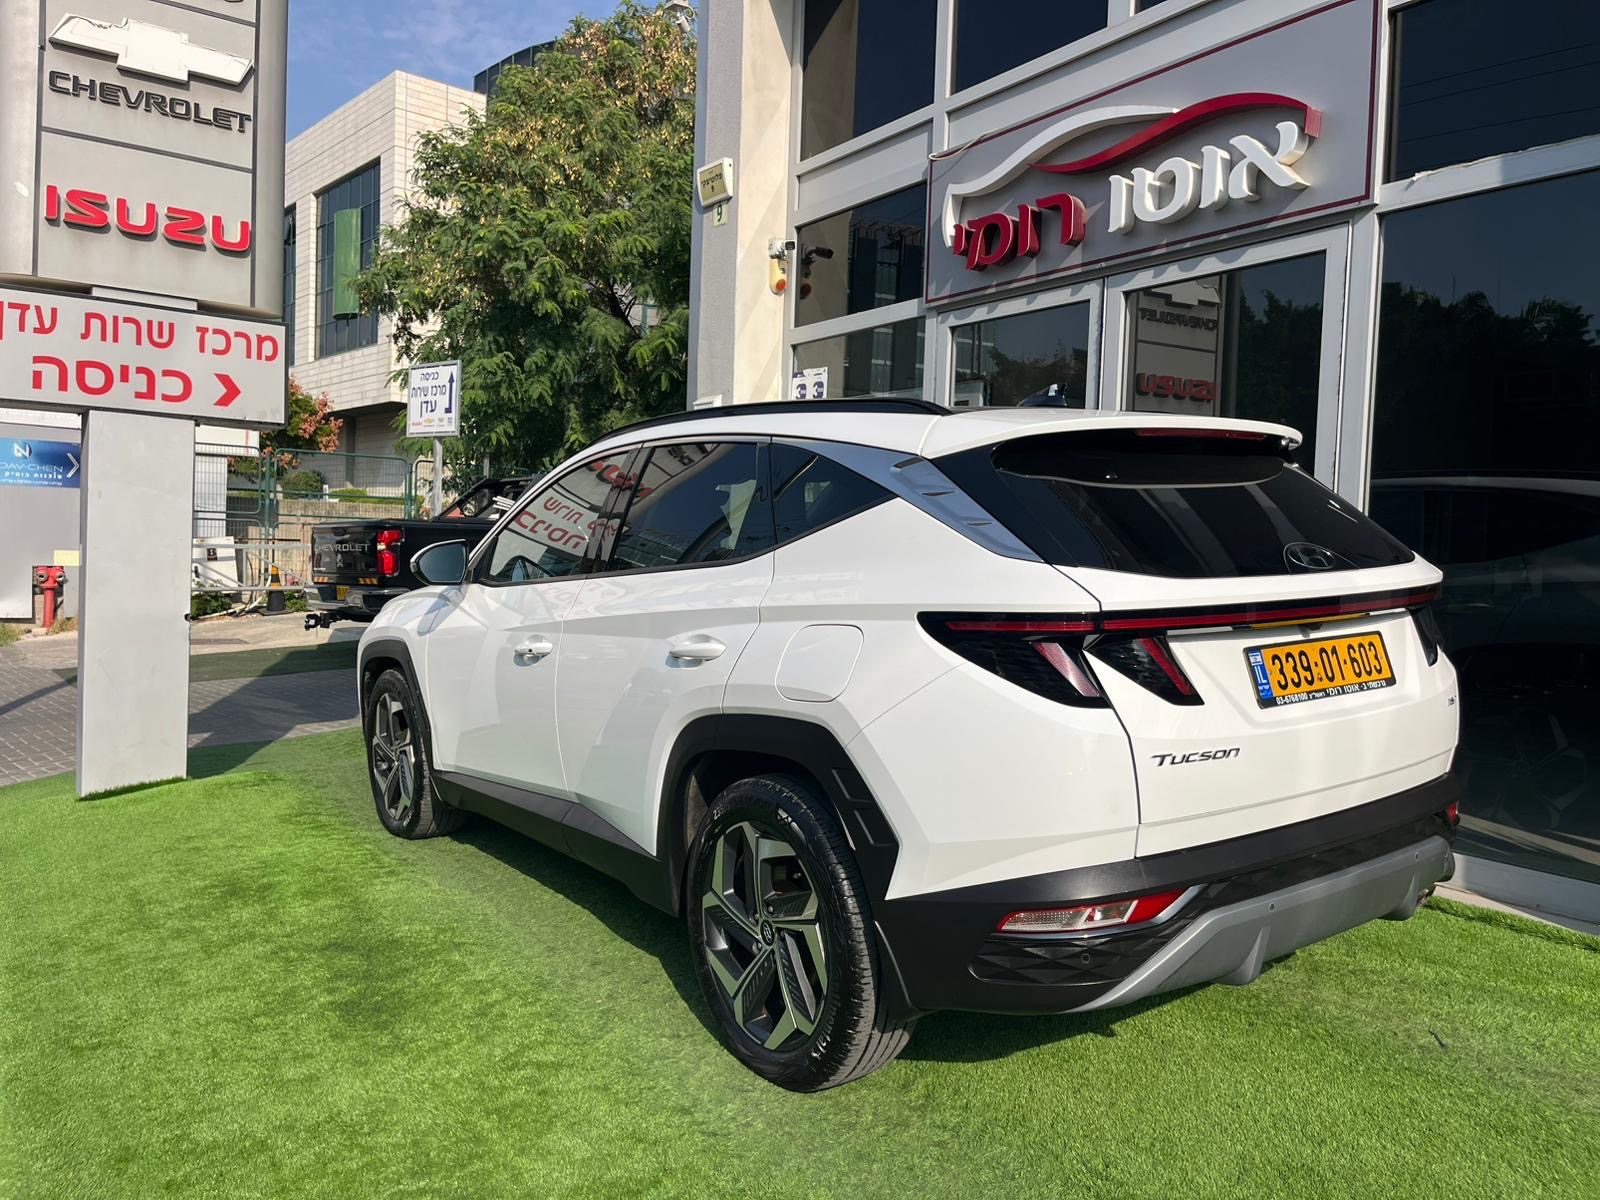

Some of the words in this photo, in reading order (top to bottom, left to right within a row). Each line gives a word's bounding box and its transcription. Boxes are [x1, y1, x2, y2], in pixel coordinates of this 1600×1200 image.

[49, 70, 252, 133] CHEVROLET
[1107, 121, 1312, 235] אוטו
[45, 184, 252, 252] ISUZU
[717, 204, 723, 222] 9
[953, 192, 1087, 271] רומי
[0, 301, 58, 340] עדן
[81, 312, 176, 348] שרות
[195, 325, 279, 361] מרכז
[32, 355, 192, 403] כניסה
[420, 371, 439, 381] כניסה
[431, 384, 447, 396] מרכז
[420, 400, 437, 418] עדן
[314, 543, 370, 553] CHEVROLET
[1253, 665, 1267, 684] IL
[1326, 686, 1342, 696] רומי
[1344, 684, 1360, 693] אוטו
